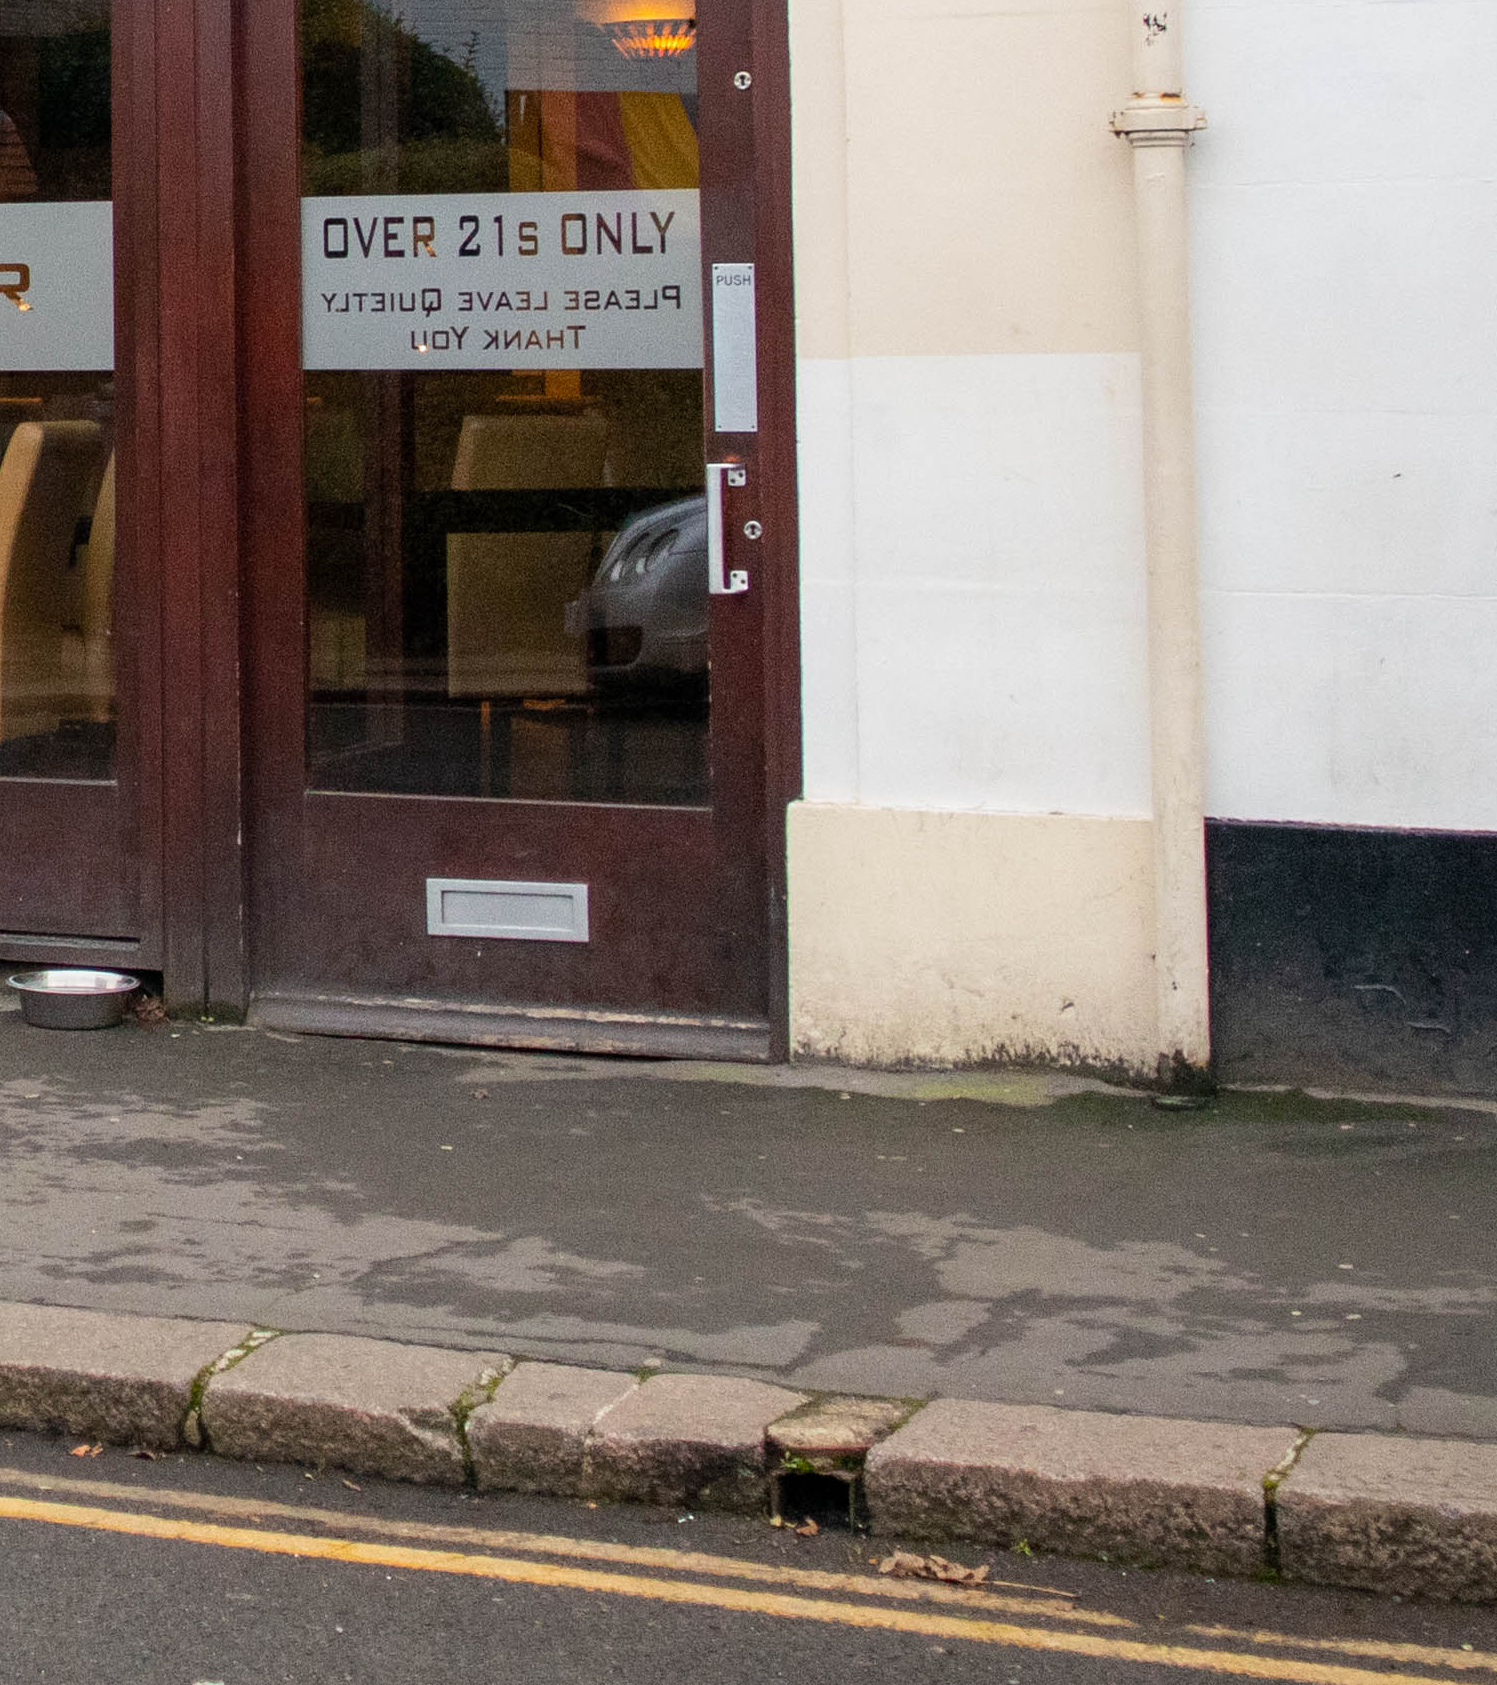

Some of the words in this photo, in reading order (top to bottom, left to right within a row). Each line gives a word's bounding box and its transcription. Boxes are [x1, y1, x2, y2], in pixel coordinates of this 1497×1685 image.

[323, 215, 437, 259] OVER
[458, 214, 539, 258] 21s
[560, 211, 676, 256] ONLY
[716, 274, 752, 287] PUSH
